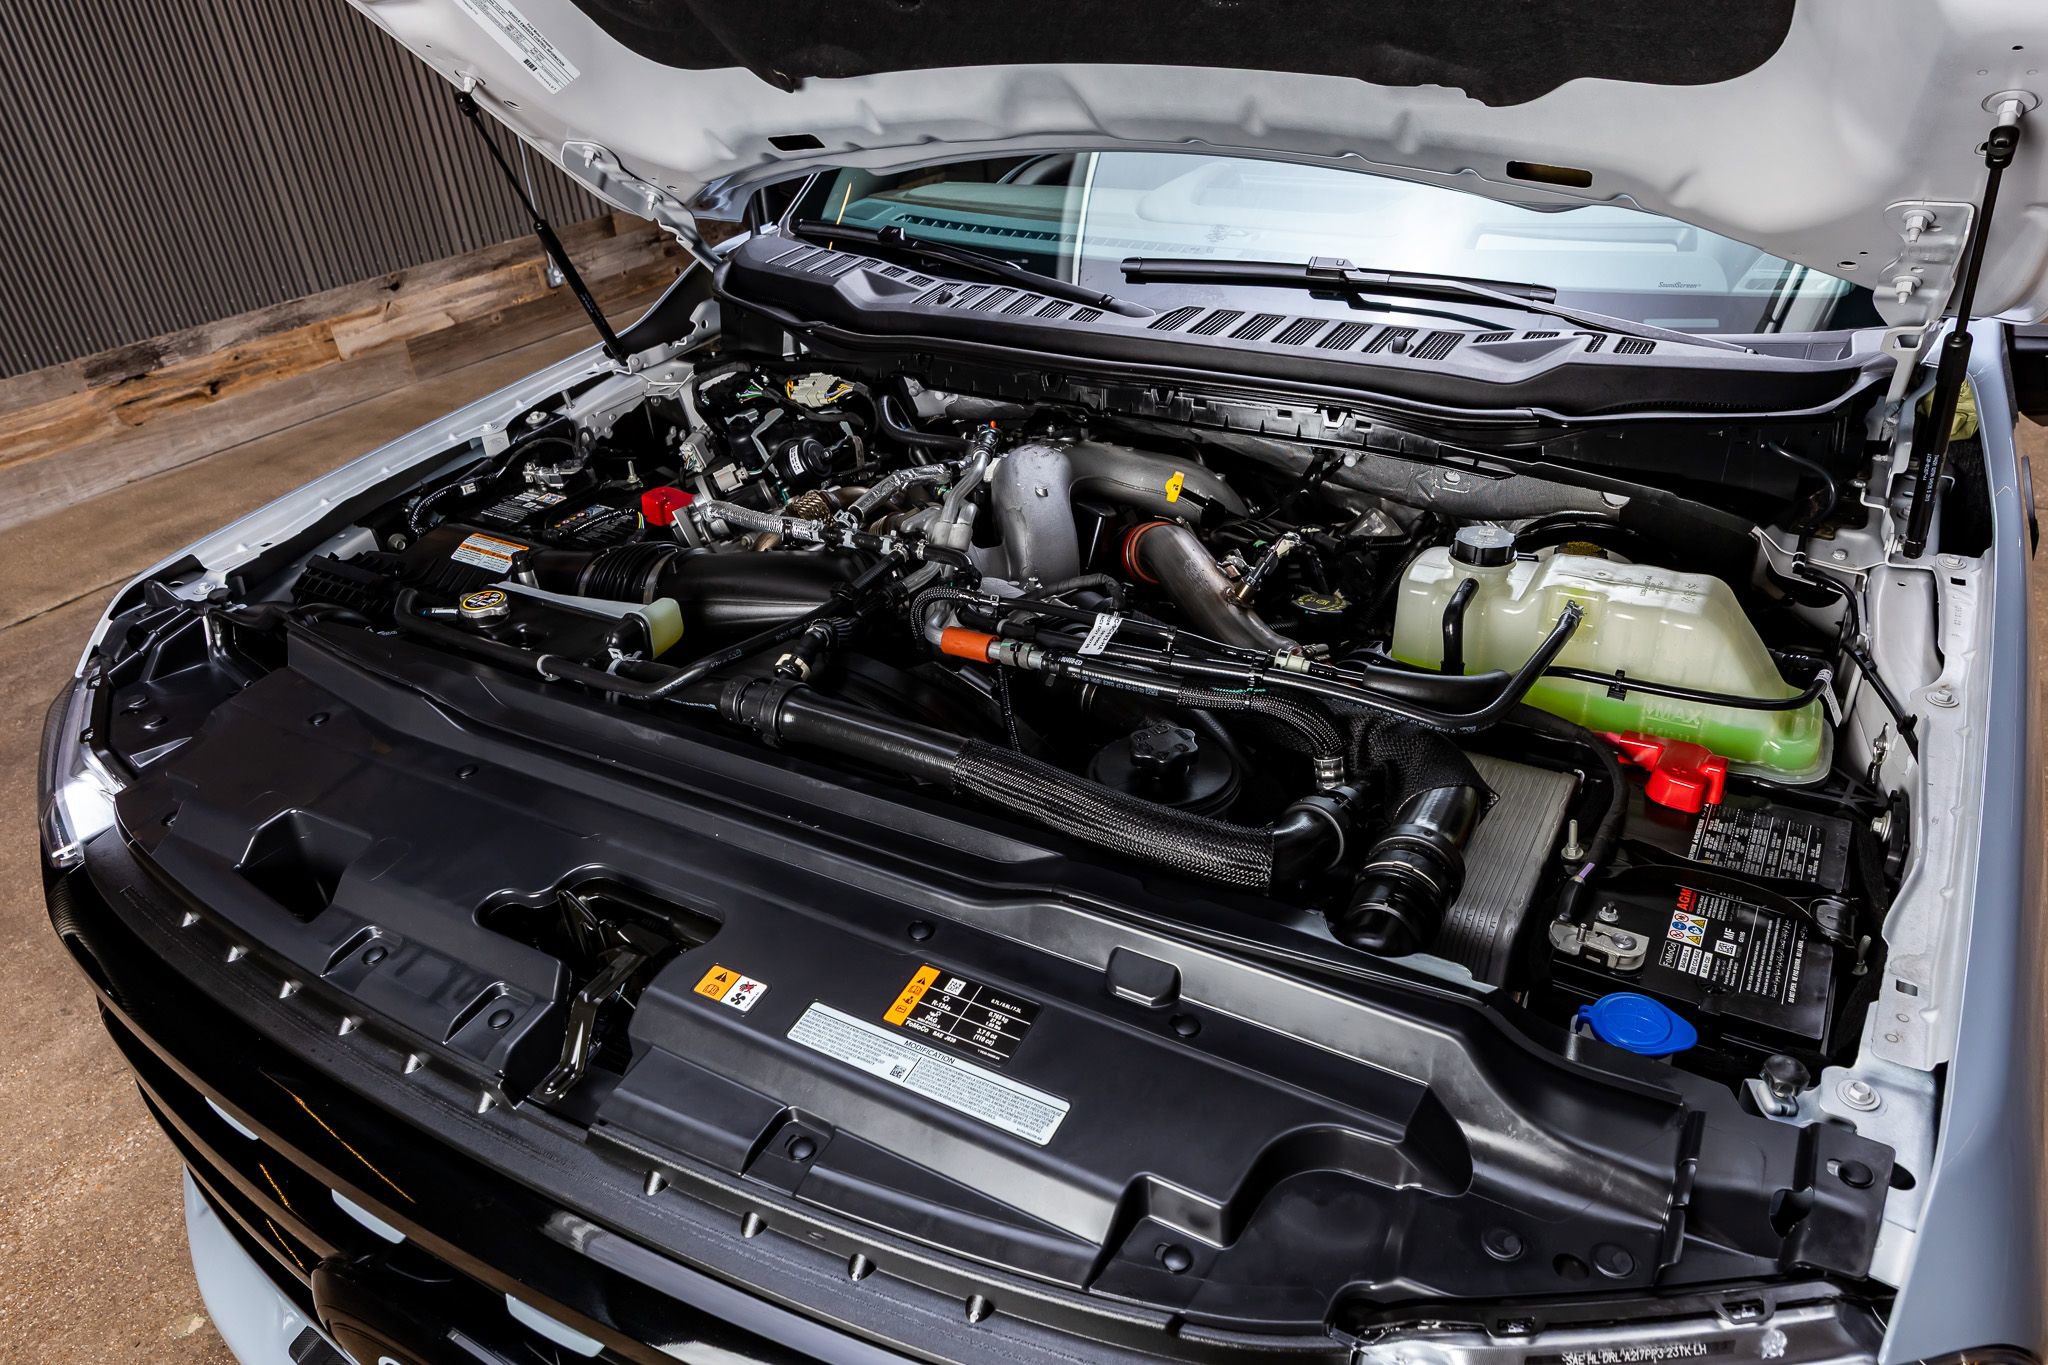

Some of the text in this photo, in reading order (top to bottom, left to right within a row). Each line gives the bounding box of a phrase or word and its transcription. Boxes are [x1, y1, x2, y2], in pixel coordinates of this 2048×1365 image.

[1676, 887, 1692, 910] AGM
[1723, 927, 1735, 940] MF
[1662, 941, 1677, 967] FoMoCo
[931, 999, 951, 1011] R-134a
[924, 1013, 938, 1024] PAG
[905, 1019, 929, 1033] FoMoCo
[932, 1029, 944, 1039] SAE
[976, 1027, 985, 1035] 3.7
[972, 1032, 985, 1043] (110
[903, 1039, 955, 1065] MODIFICATION
[1566, 1353, 1585, 1365] SAE
[1587, 1352, 1600, 1365] HL
[1603, 1351, 1622, 1363] DRL
[1694, 1344, 1707, 1355] LH
